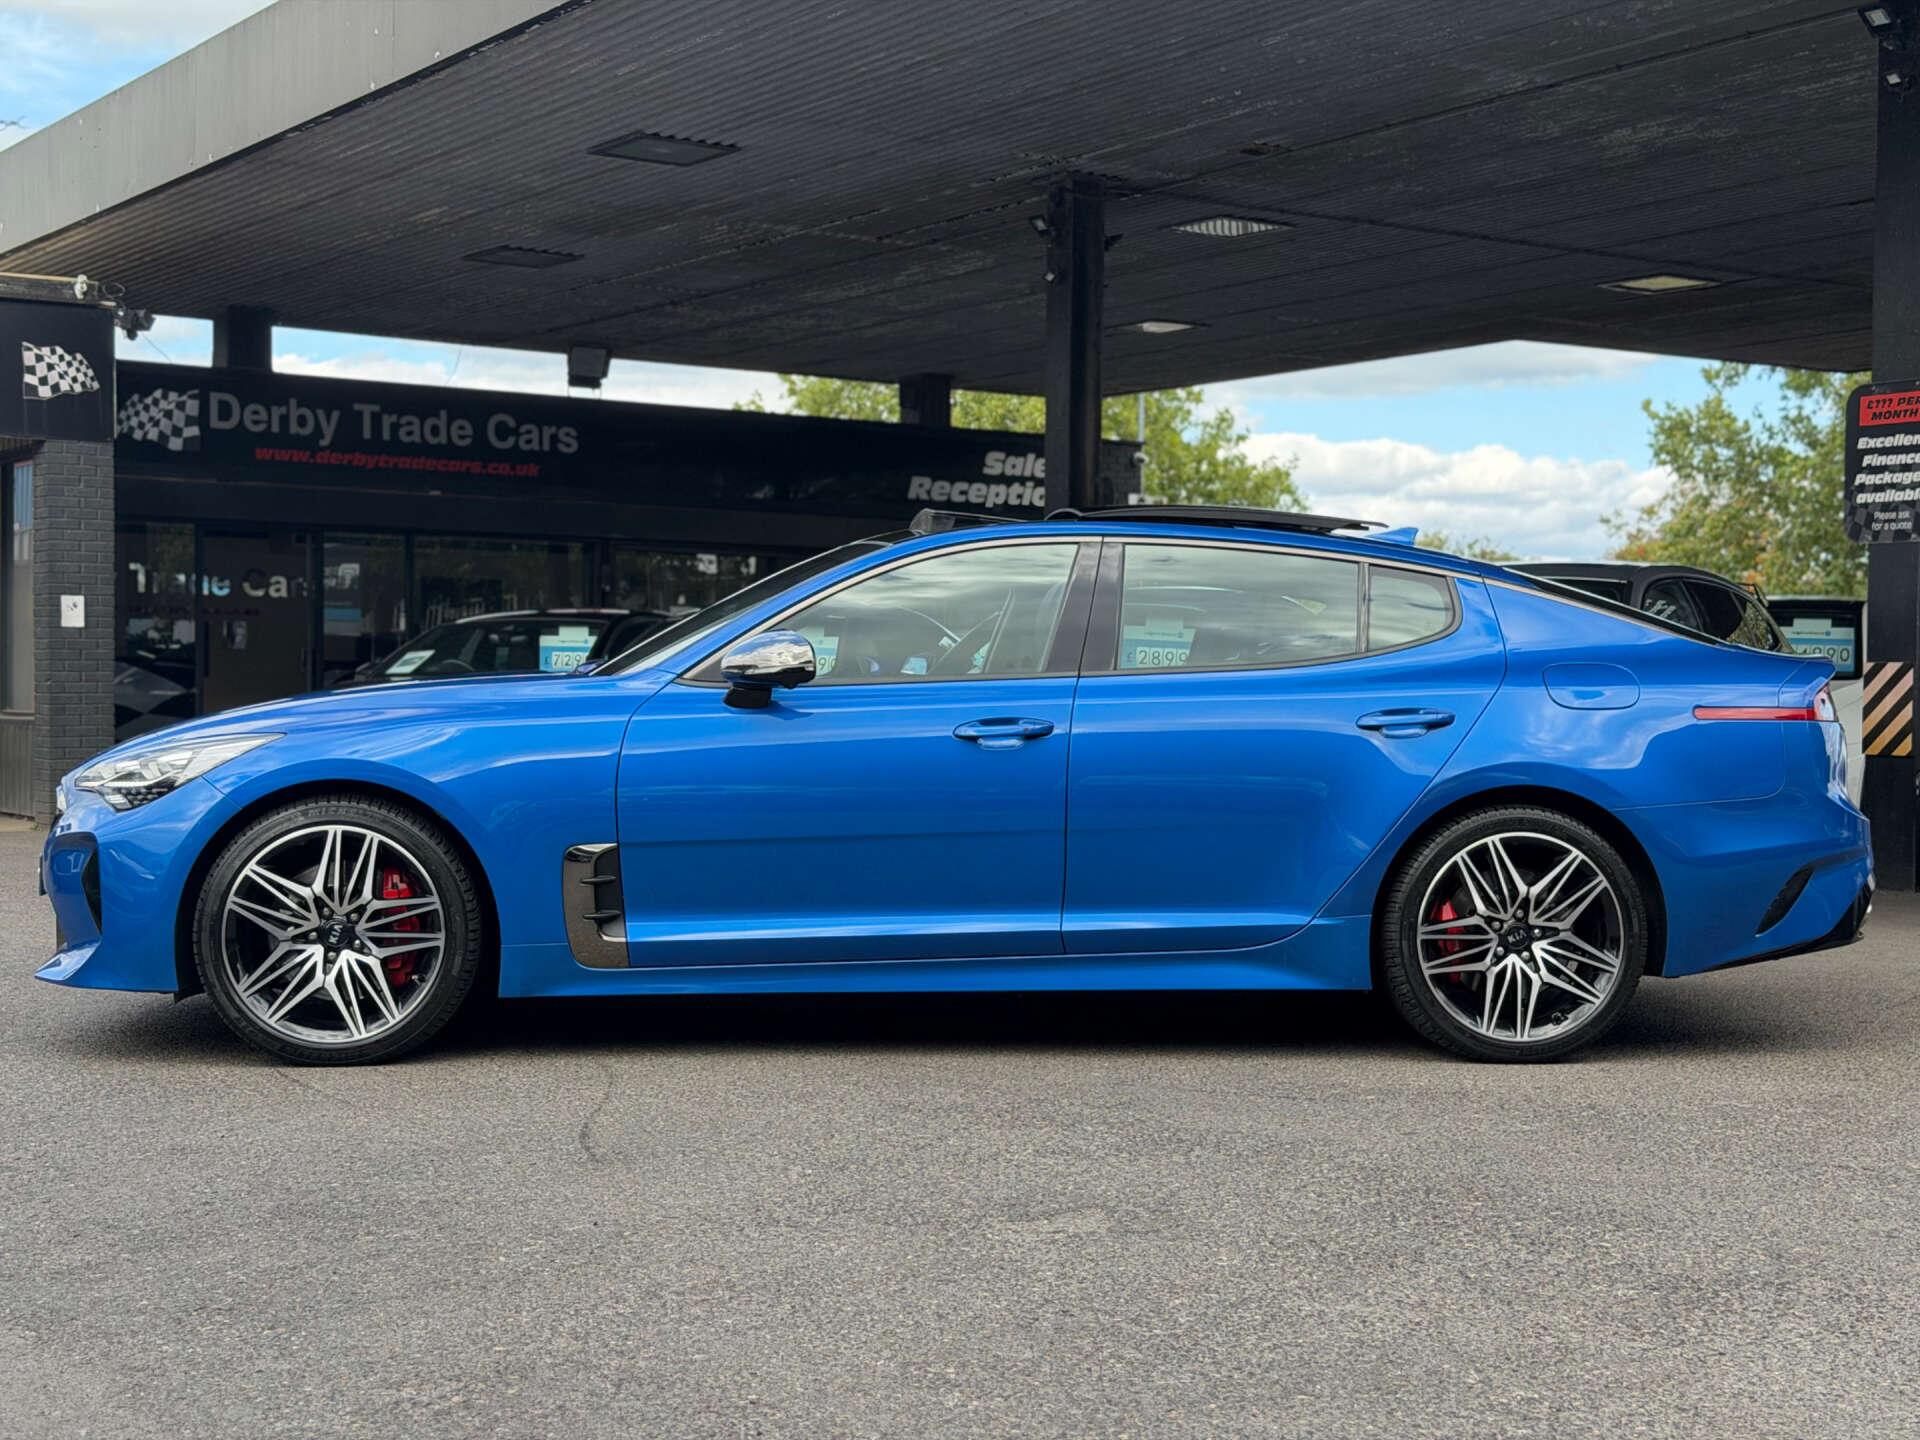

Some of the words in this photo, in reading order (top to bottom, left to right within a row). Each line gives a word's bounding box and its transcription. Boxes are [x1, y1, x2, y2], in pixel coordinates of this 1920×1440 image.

[209, 391, 341, 447] Derby
[353, 403, 474, 447] Trade
[487, 413, 579, 453] Cars
[1871, 408, 1919, 420] MONTH
[255, 448, 540, 477] www.derbytradecars.co.uk
[982, 451, 1046, 479] Sale
[1862, 453, 1920, 468] Finance
[328, 924, 344, 944] KIA
[1507, 929, 1527, 943] KIA
